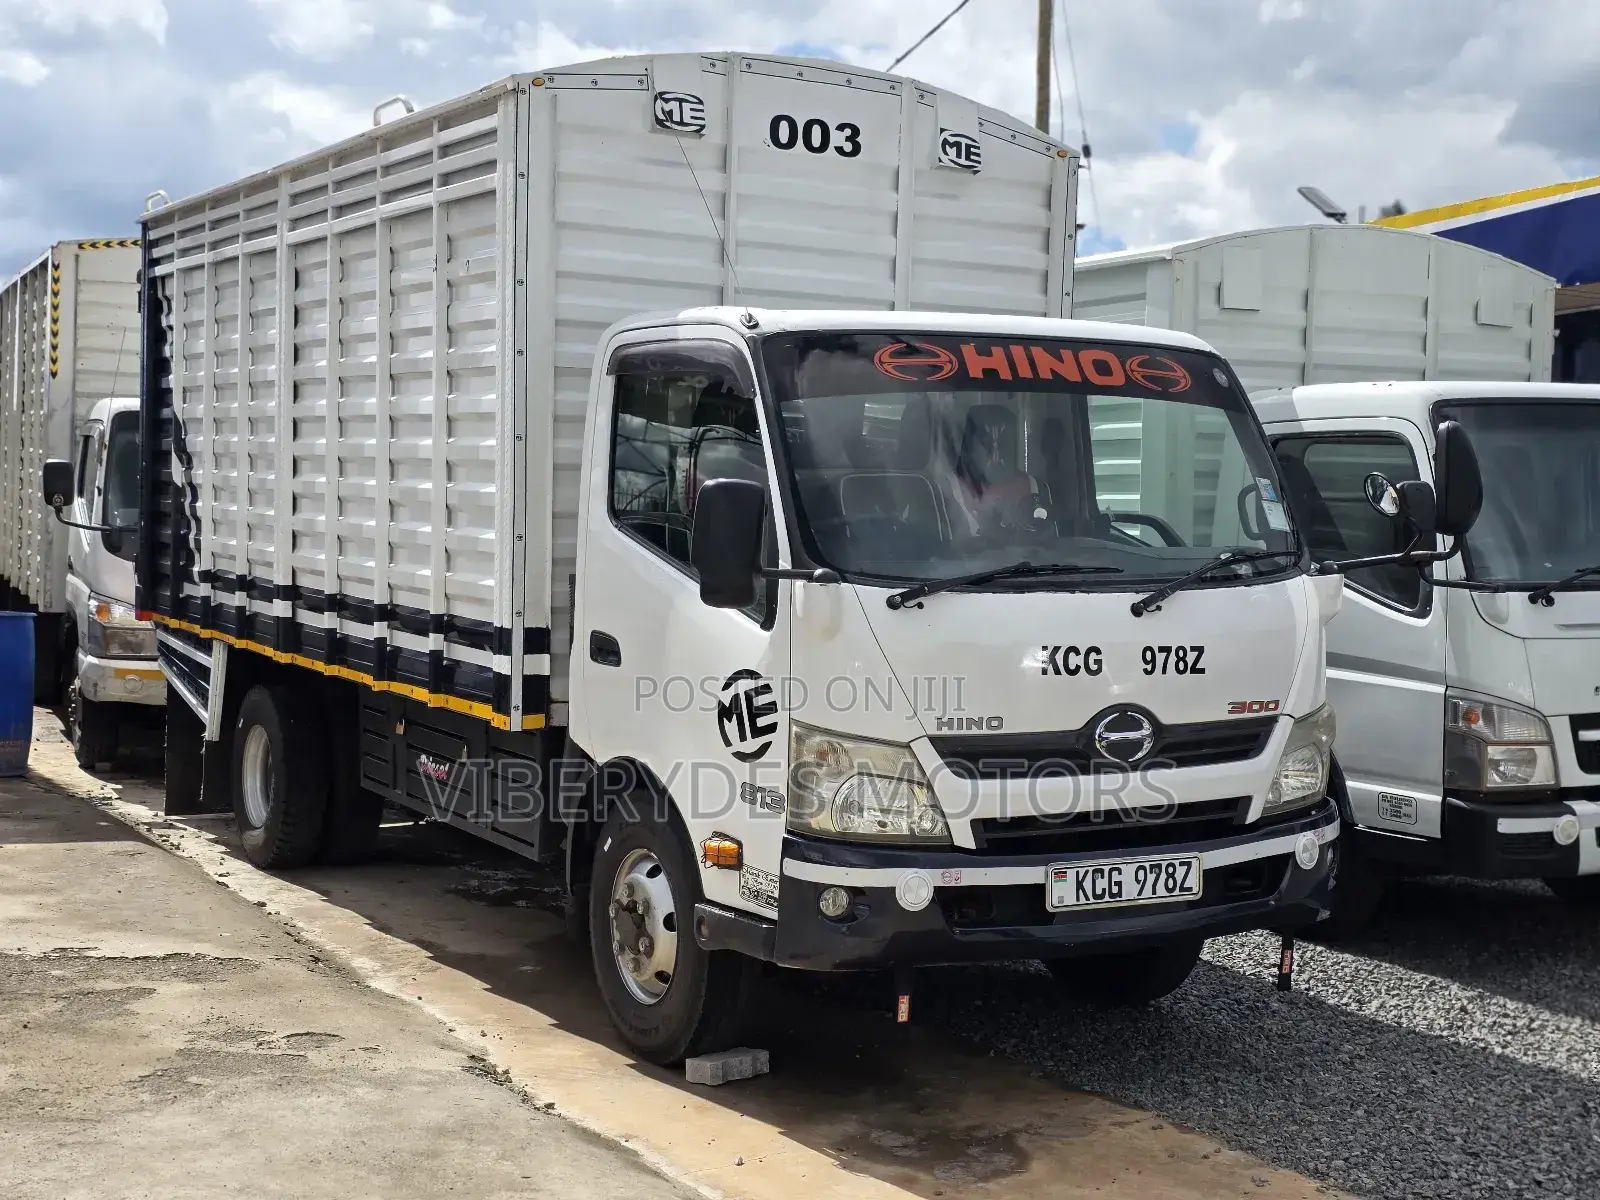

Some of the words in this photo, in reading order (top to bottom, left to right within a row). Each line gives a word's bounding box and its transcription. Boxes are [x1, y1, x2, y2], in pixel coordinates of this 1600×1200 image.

[654, 96, 705, 130] ME
[769, 114, 862, 158] 003
[941, 135, 981, 167] ME
[960, 344, 1126, 386] HINO
[1041, 645, 1103, 676] KCG
[1141, 645, 1206, 675] 978Z
[718, 680, 778, 750] ME
[936, 716, 1004, 731] HINO
[1228, 700, 1280, 714] 300
[740, 781, 786, 814] 813
[1076, 867, 1123, 902] KCG
[1134, 860, 1193, 897] 978Z
